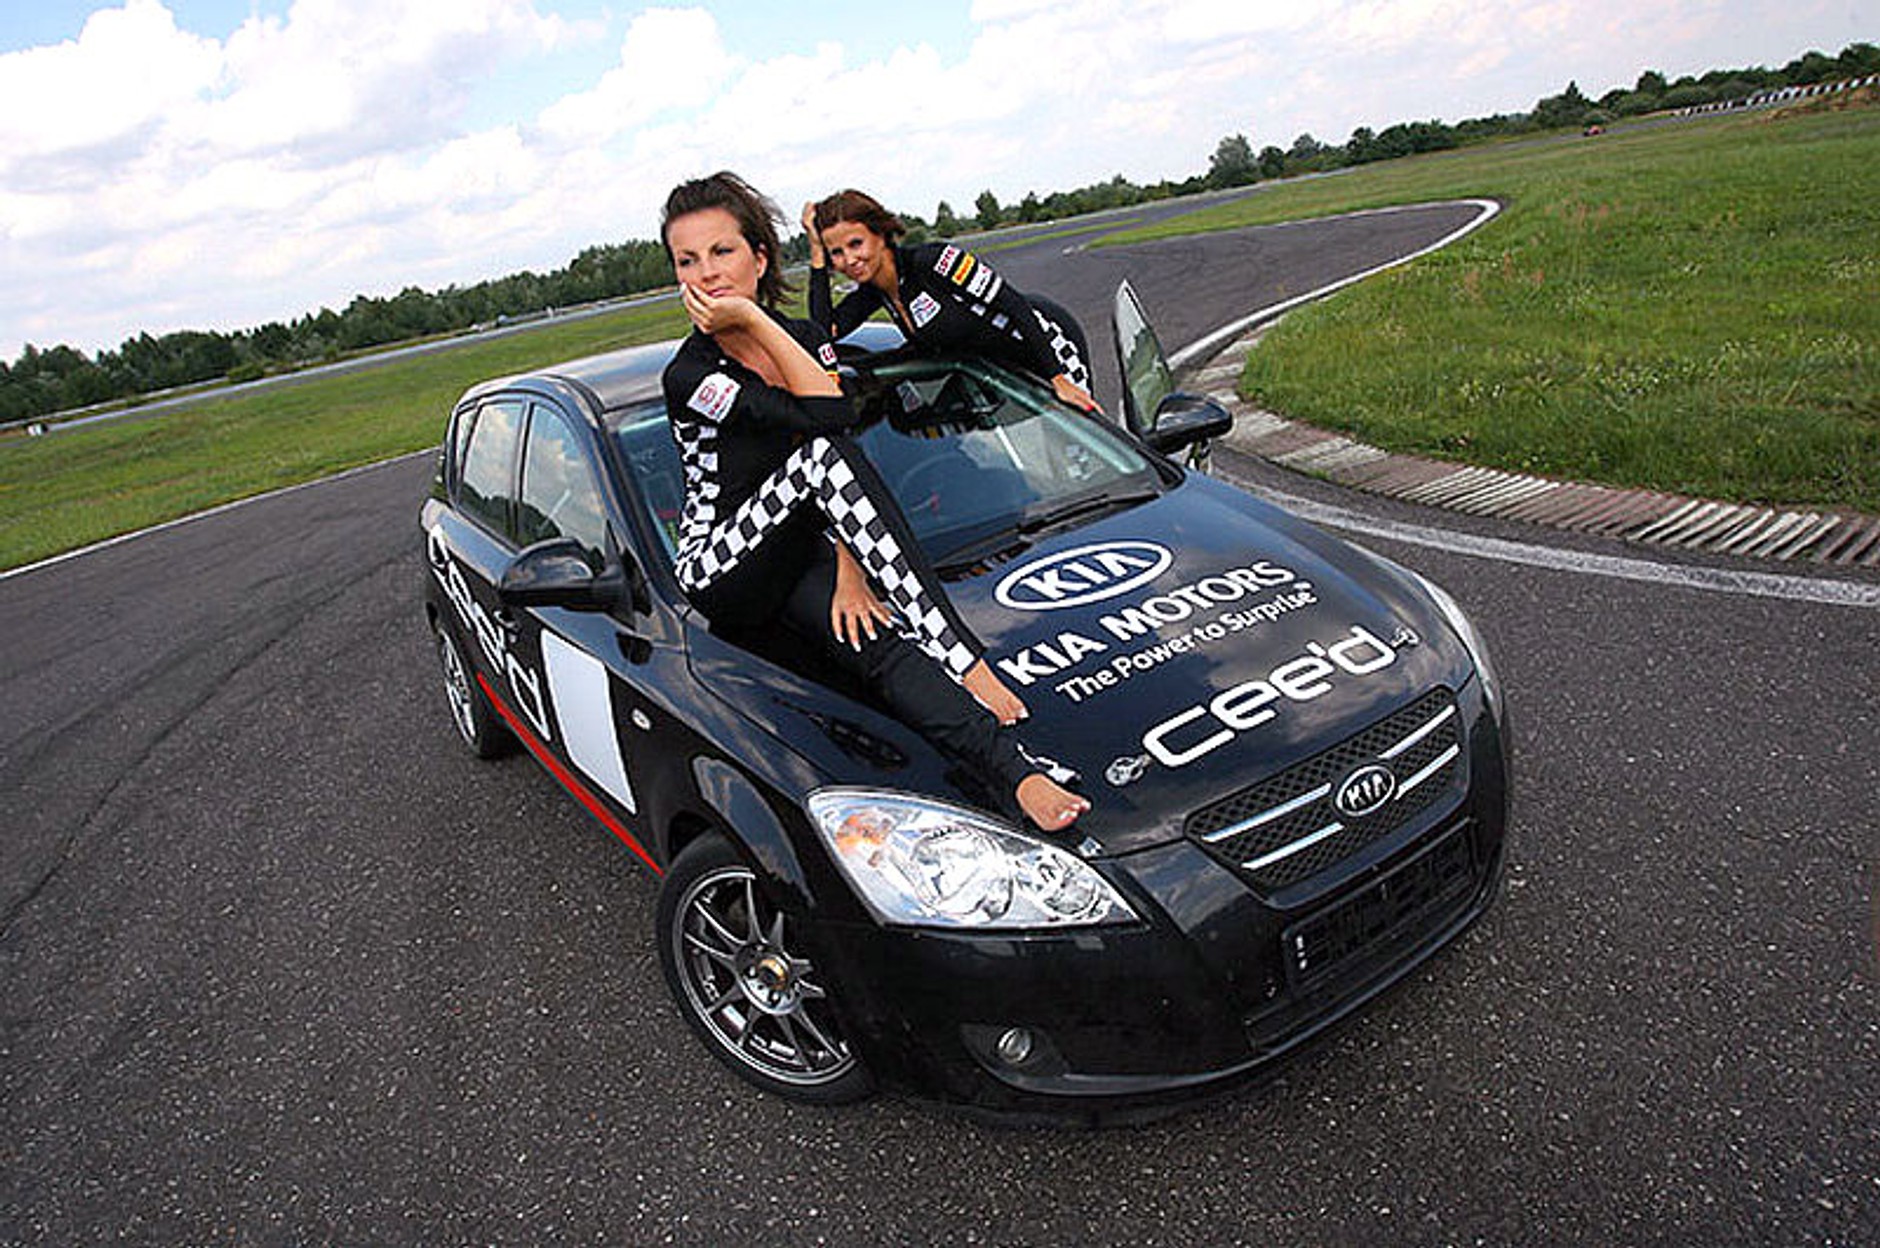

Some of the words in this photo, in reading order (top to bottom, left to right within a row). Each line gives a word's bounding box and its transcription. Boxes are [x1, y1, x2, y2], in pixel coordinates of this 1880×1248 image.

[999, 632, 1109, 686] KIA
[1100, 561, 1296, 641] MOTORS
[1020, 549, 1149, 601] KIA
[1055, 669, 1118, 703] The
[1112, 634, 1195, 678] Power
[1194, 623, 1225, 642] to
[1220, 591, 1318, 632] Surprise
[1143, 625, 1397, 768] cee'd
[1347, 773, 1388, 809] KIA
